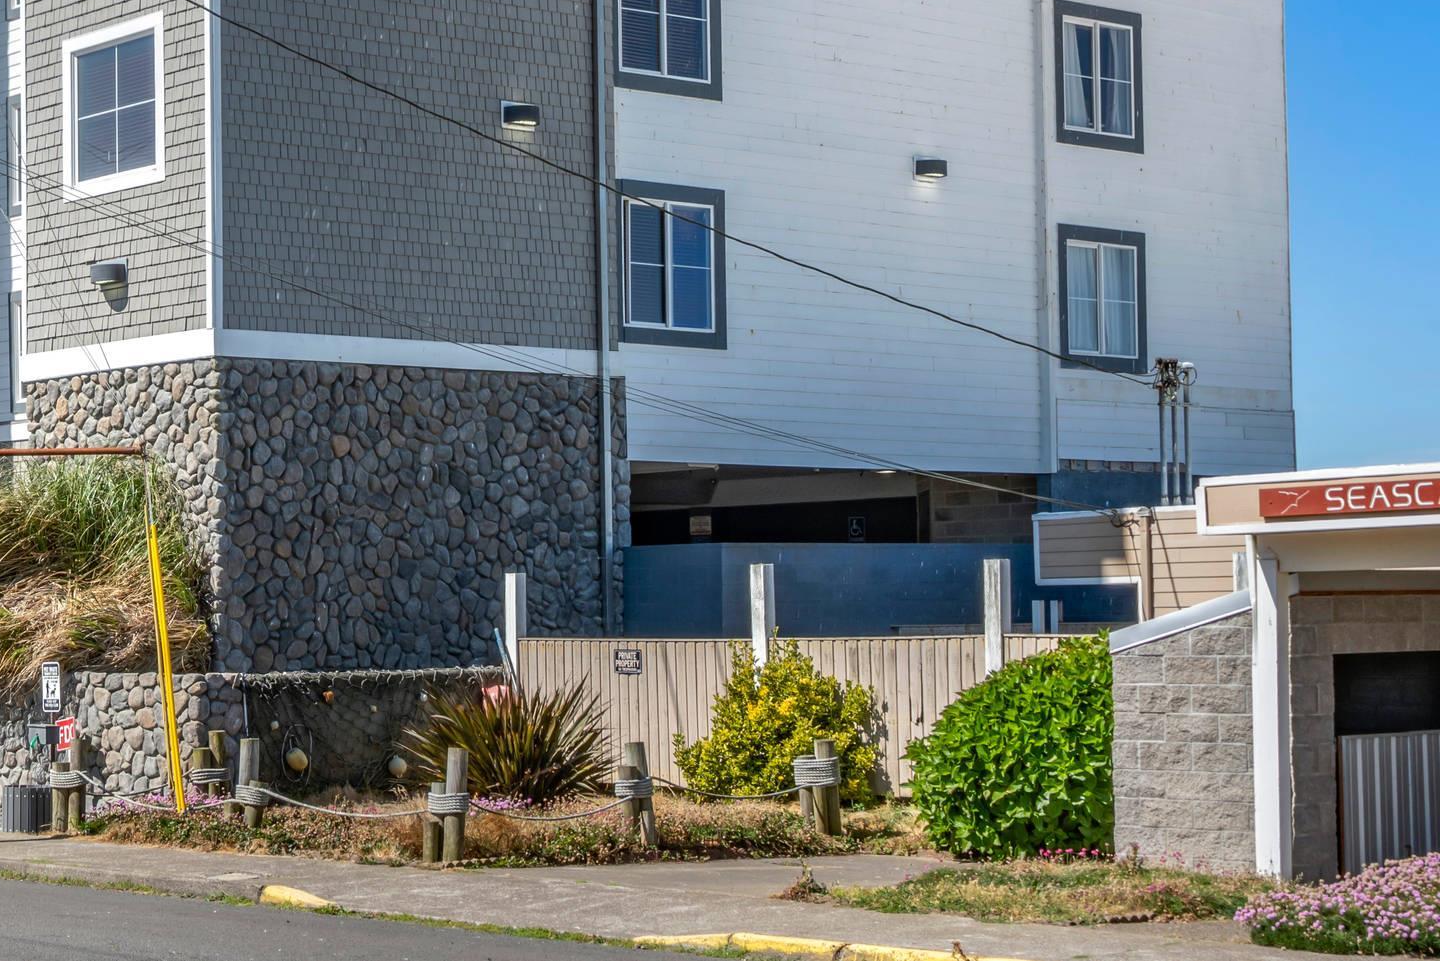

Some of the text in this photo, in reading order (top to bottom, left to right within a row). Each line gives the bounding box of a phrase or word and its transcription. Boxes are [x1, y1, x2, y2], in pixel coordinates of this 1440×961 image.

[1324, 480, 1440, 512] SEASC
[618, 651, 637, 660] PRIVATE
[615, 659, 640, 668] PROPERTY
